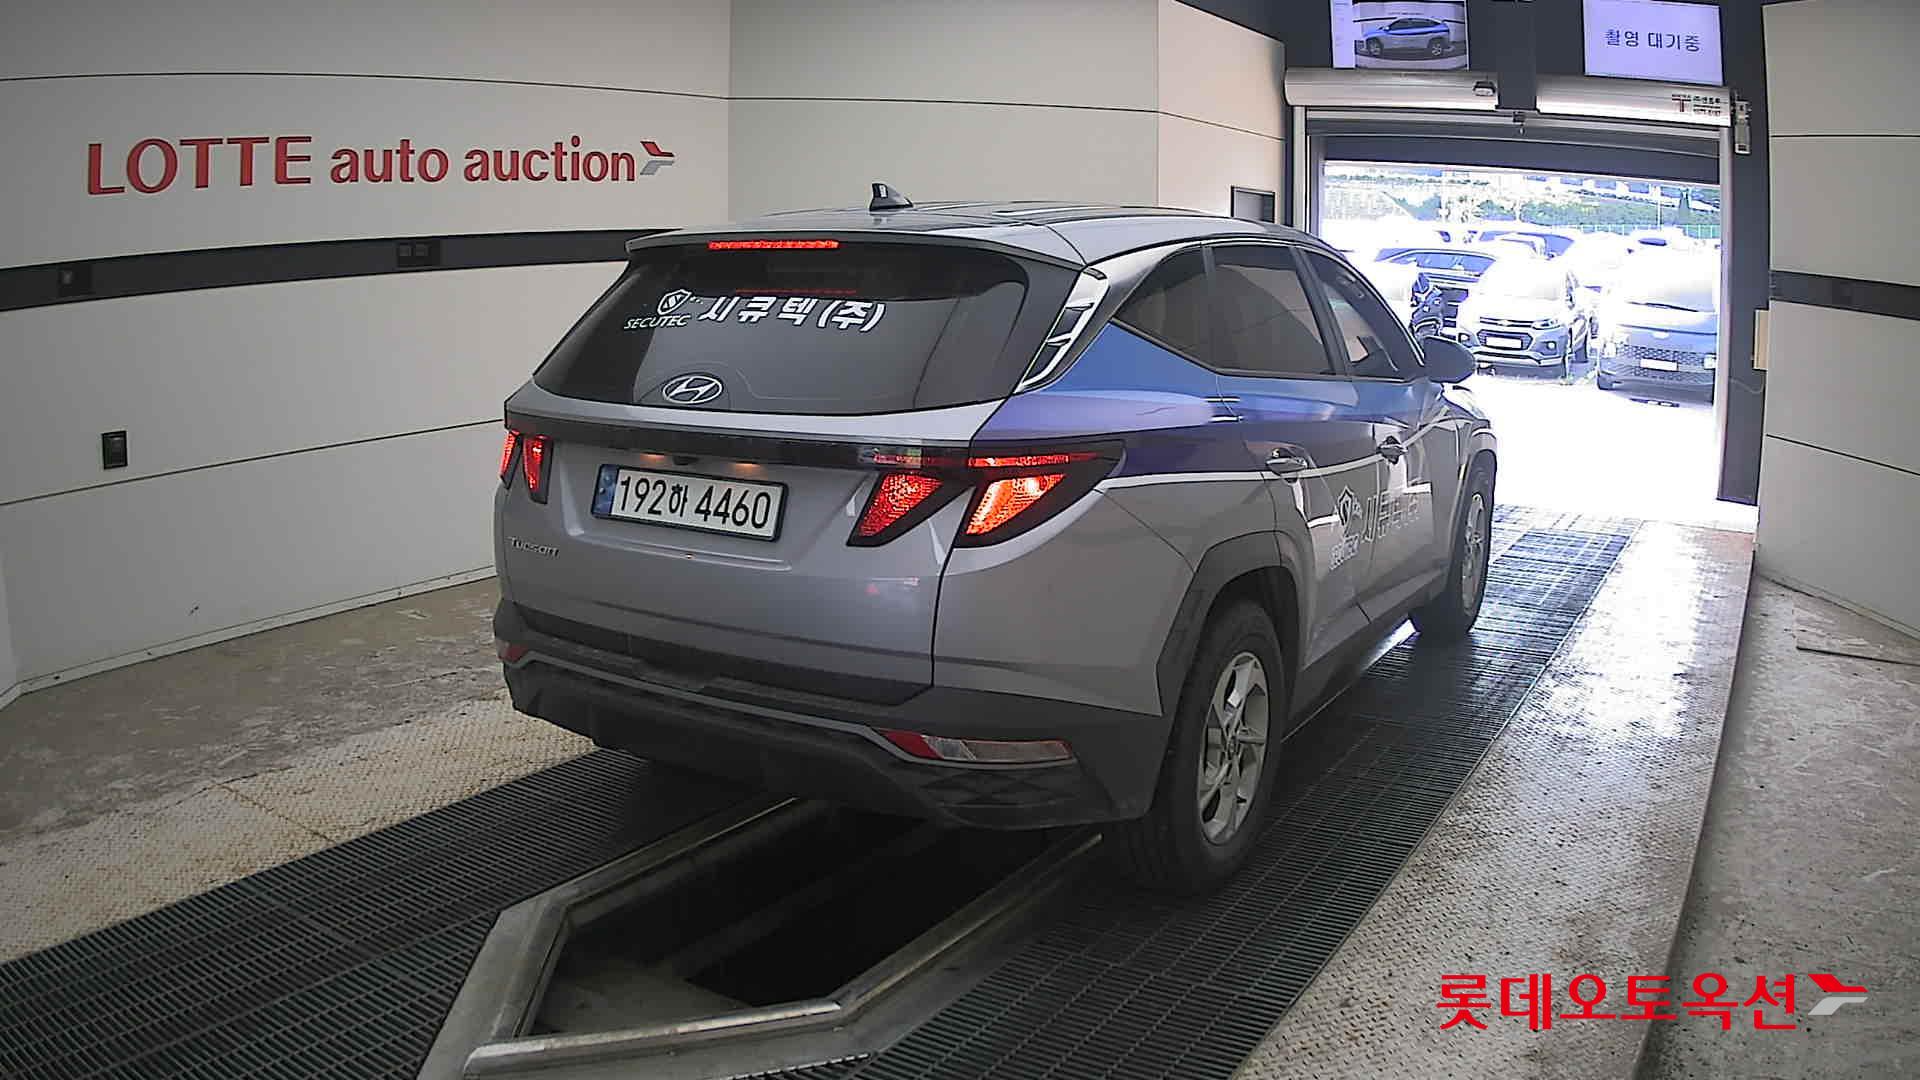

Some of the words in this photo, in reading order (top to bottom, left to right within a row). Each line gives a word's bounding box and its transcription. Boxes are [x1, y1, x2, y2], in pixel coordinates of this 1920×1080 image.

[1647, 31, 1700, 52] 대기중
[87, 136, 312, 195] LOTTE
[330, 139, 449, 184] auto
[463, 135, 635, 183] auction
[623, 314, 692, 330] SECUTEC
[620, 475, 689, 518] 192하
[694, 484, 772, 530] 4460
